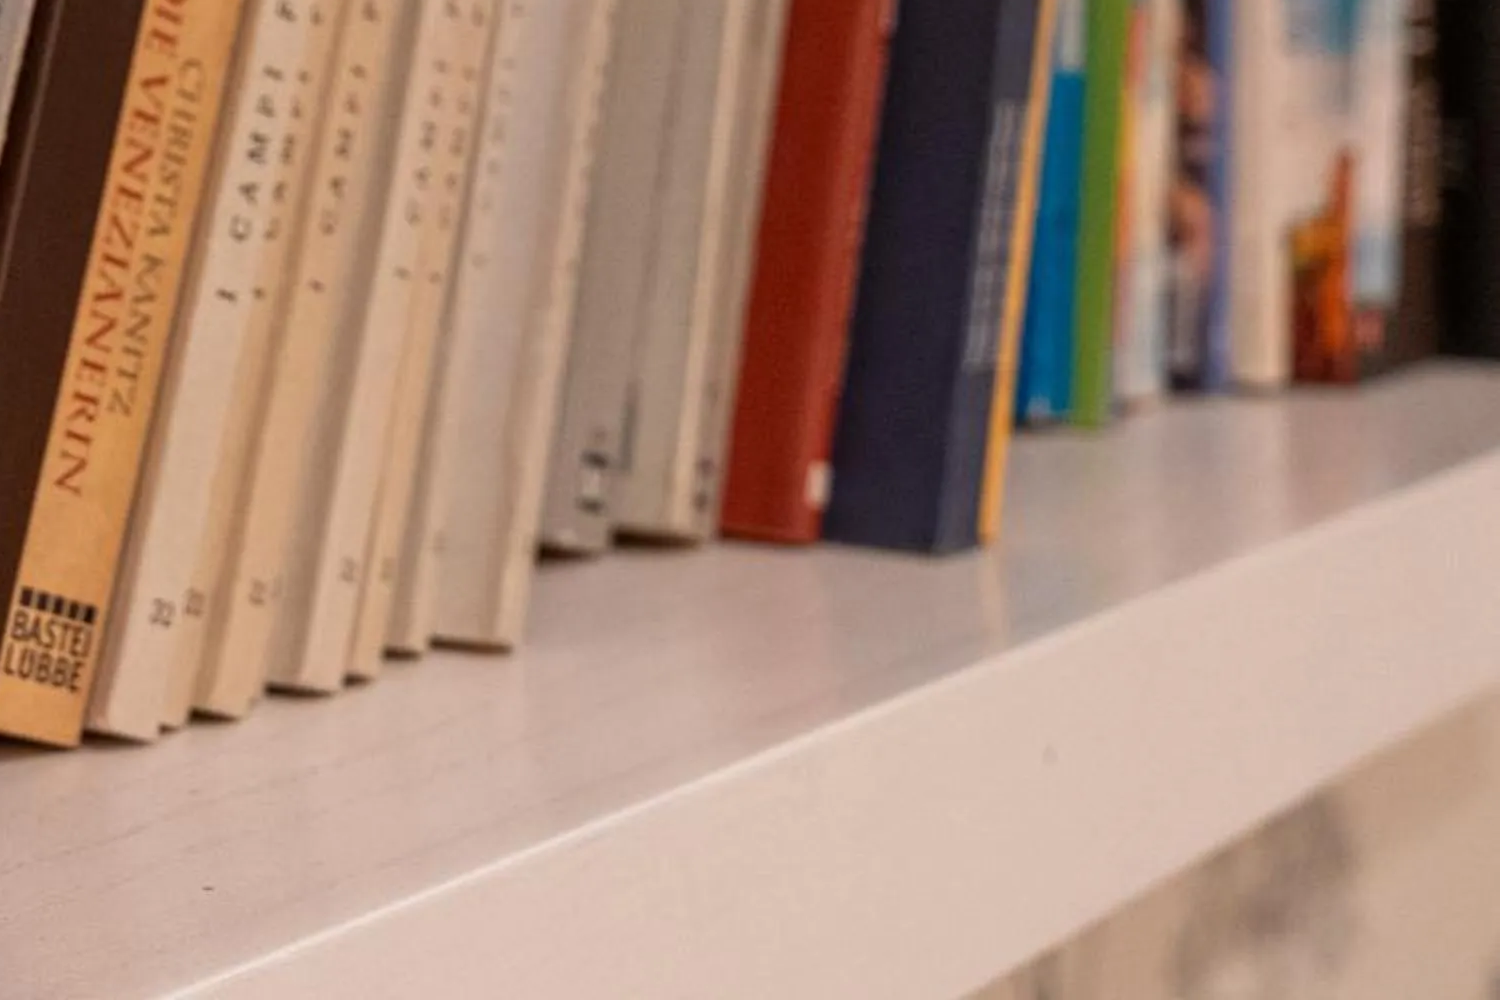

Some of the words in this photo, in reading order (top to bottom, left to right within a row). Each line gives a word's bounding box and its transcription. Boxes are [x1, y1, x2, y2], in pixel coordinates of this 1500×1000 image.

[227, 63, 284, 244] CAMPI
[54, 74, 166, 497] VENEZIANERIN
[10, 610, 92, 658] BASTEI
